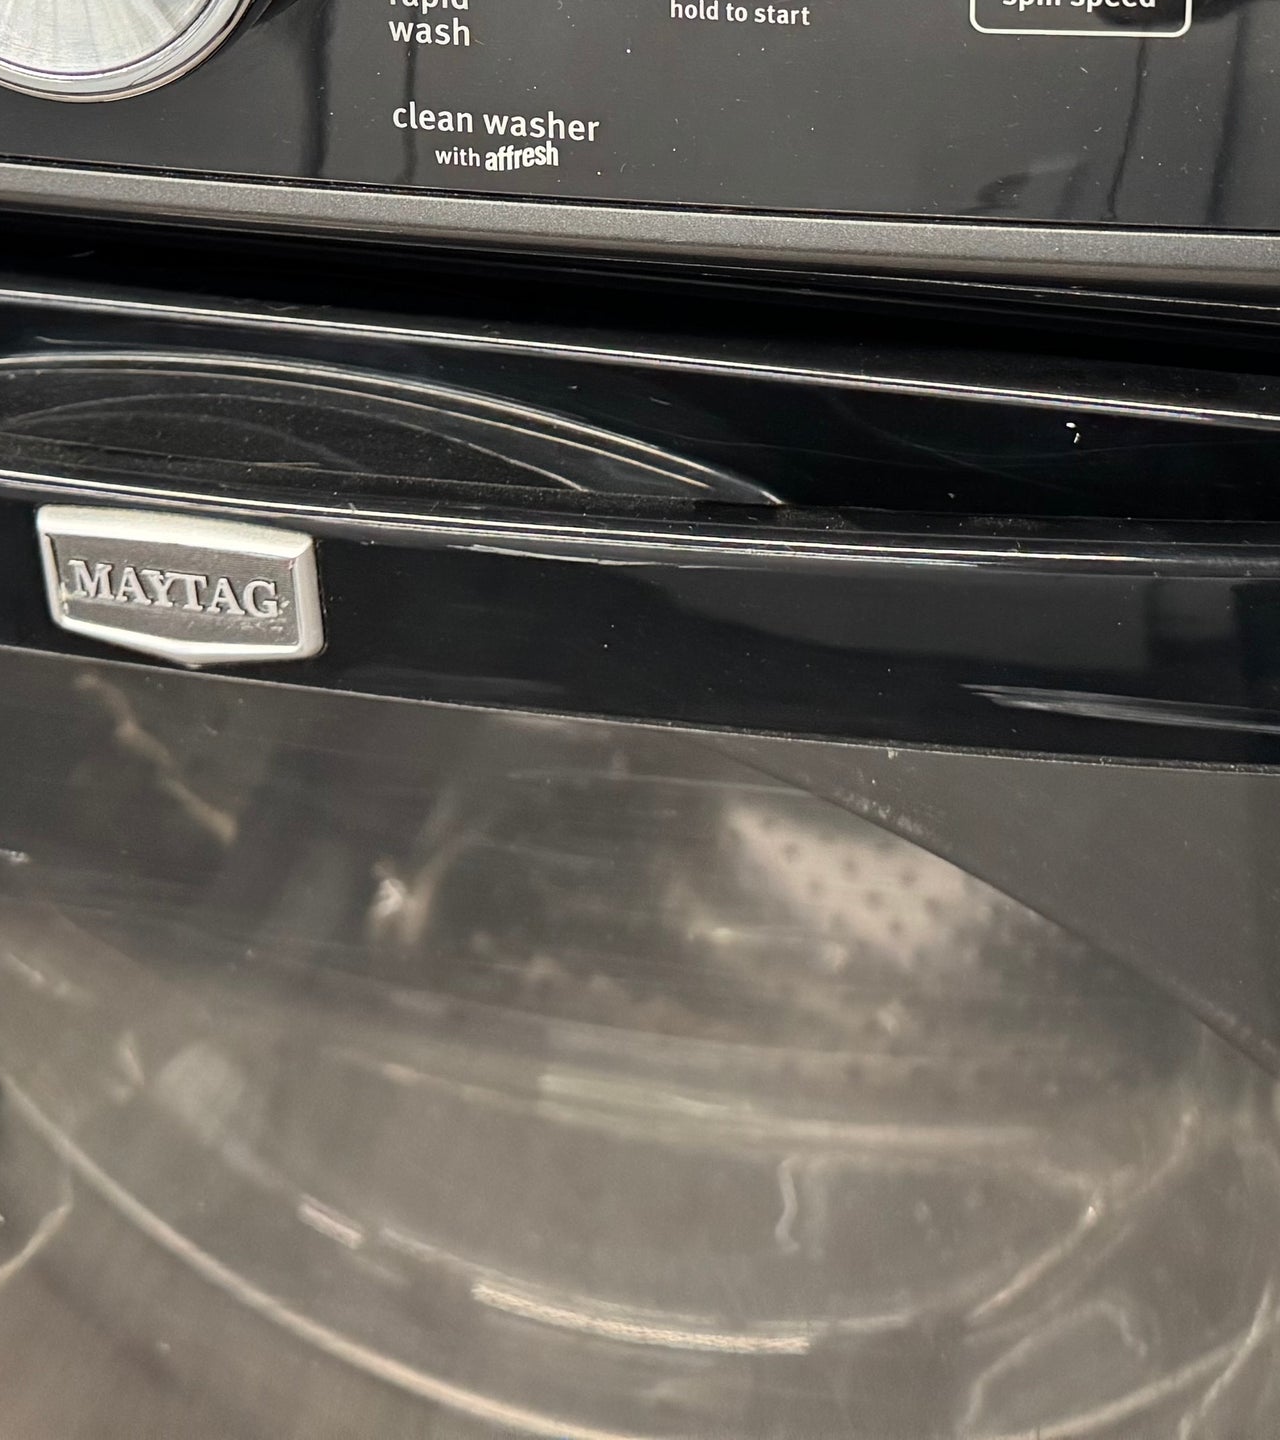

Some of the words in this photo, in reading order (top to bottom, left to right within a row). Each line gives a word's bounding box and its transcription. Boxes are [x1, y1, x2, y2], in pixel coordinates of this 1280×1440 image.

[725, 2, 748, 22] to
[754, 4, 811, 26] start
[388, 17, 470, 47] wash
[393, 101, 473, 133] clean
[483, 111, 600, 142] washer
[435, 147, 480, 167] with
[485, 140, 559, 172] affresh
[68, 559, 283, 619] MAYTAG
